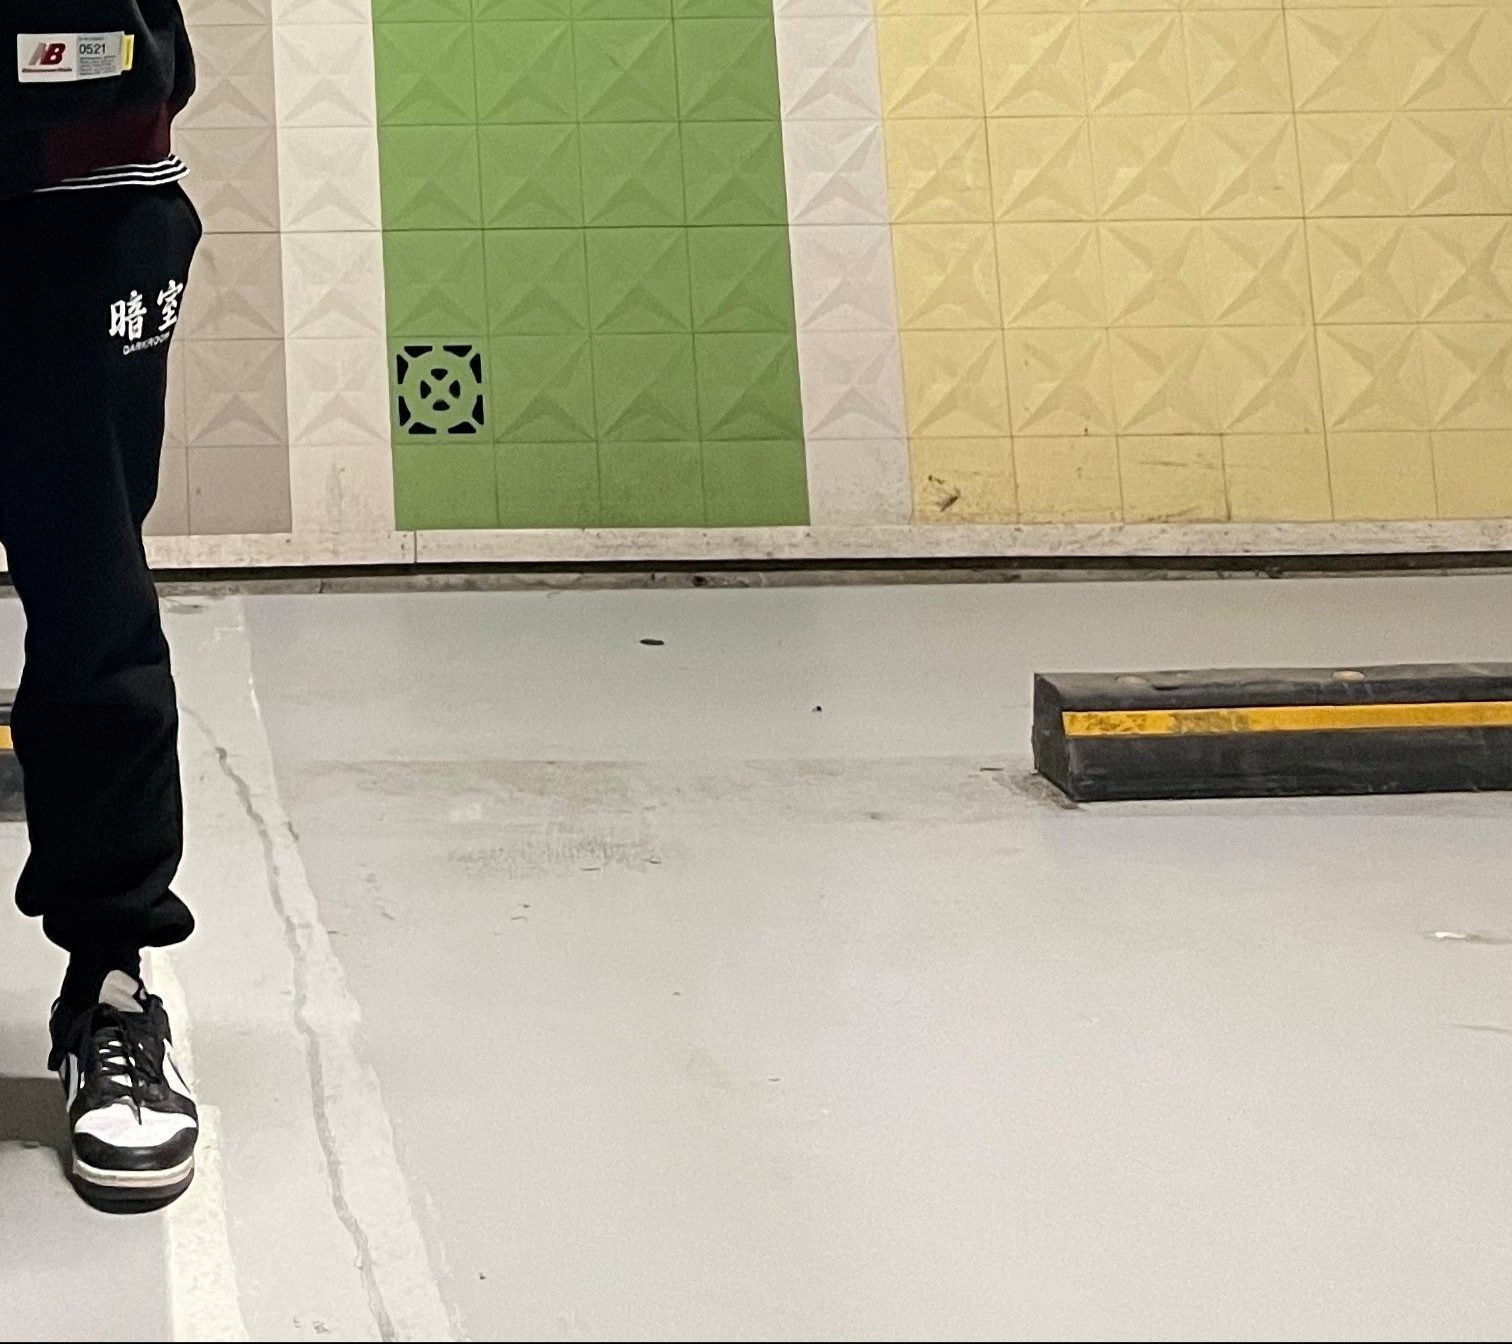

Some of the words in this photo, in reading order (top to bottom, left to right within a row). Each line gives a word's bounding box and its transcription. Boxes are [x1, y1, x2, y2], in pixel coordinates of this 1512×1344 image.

[28, 42, 66, 66] NB
[79, 43, 106, 55] 0521
[108, 279, 184, 341] 暗室
